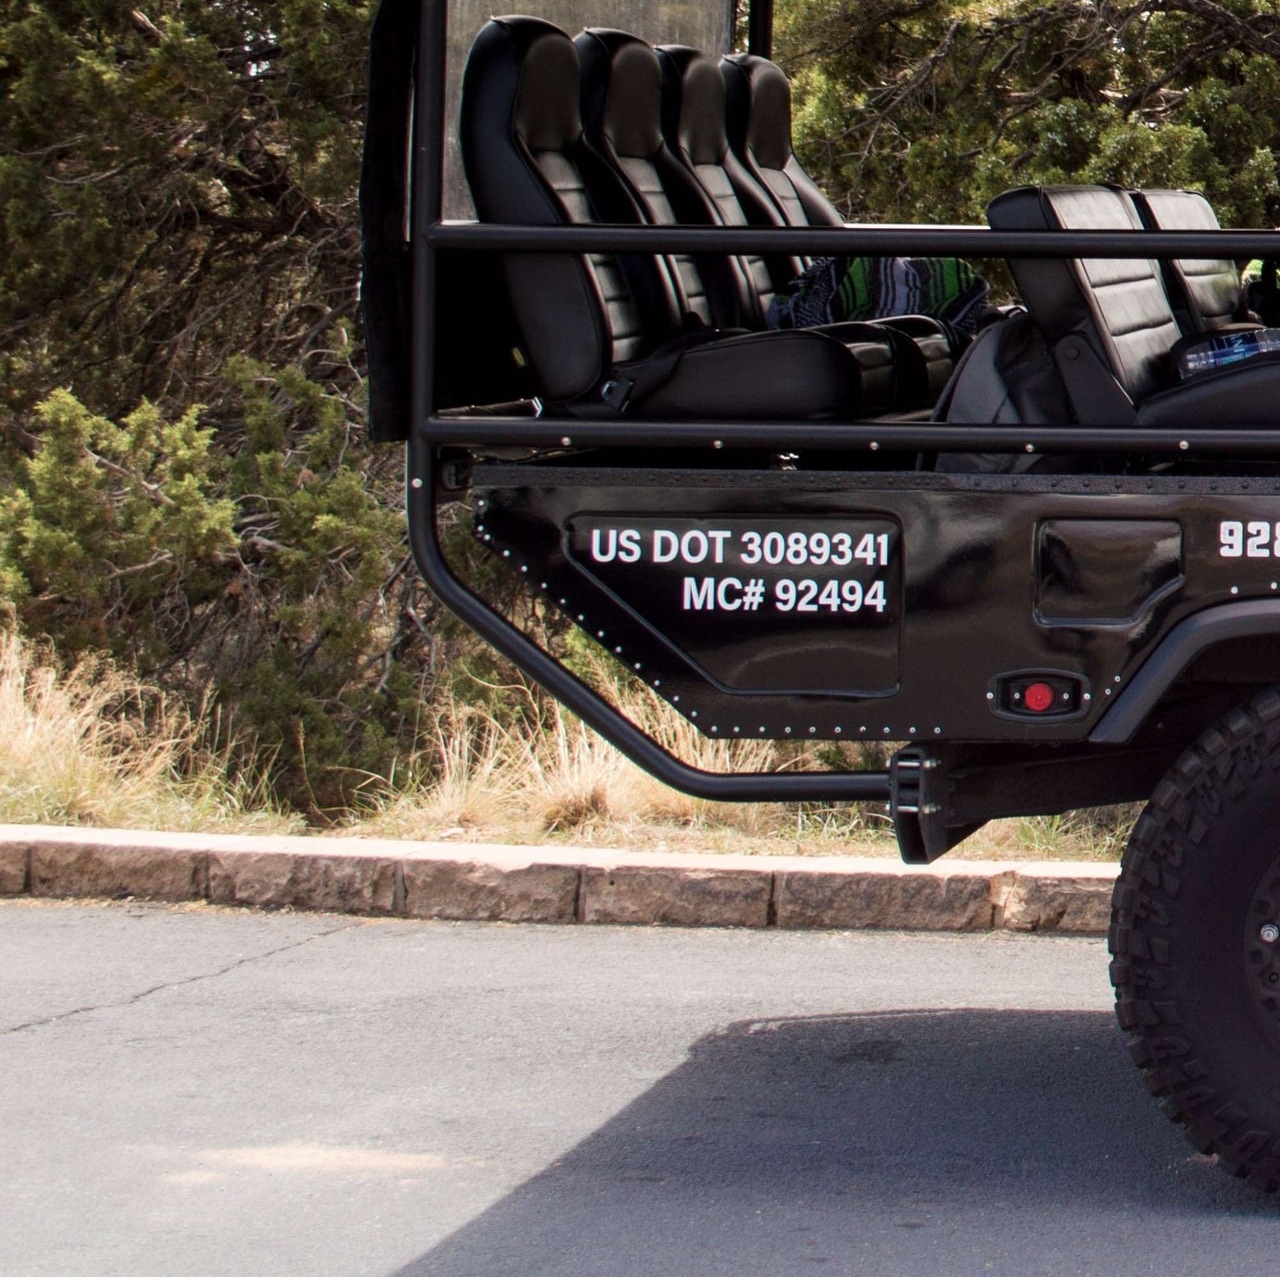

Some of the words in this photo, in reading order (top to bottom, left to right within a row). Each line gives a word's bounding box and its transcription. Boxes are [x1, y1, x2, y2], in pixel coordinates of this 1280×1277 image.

[593, 530, 640, 562] US
[654, 530, 731, 563] DOT
[741, 532, 887, 565] 3089341
[684, 578, 764, 610] MC#
[776, 579, 885, 612] 92494
